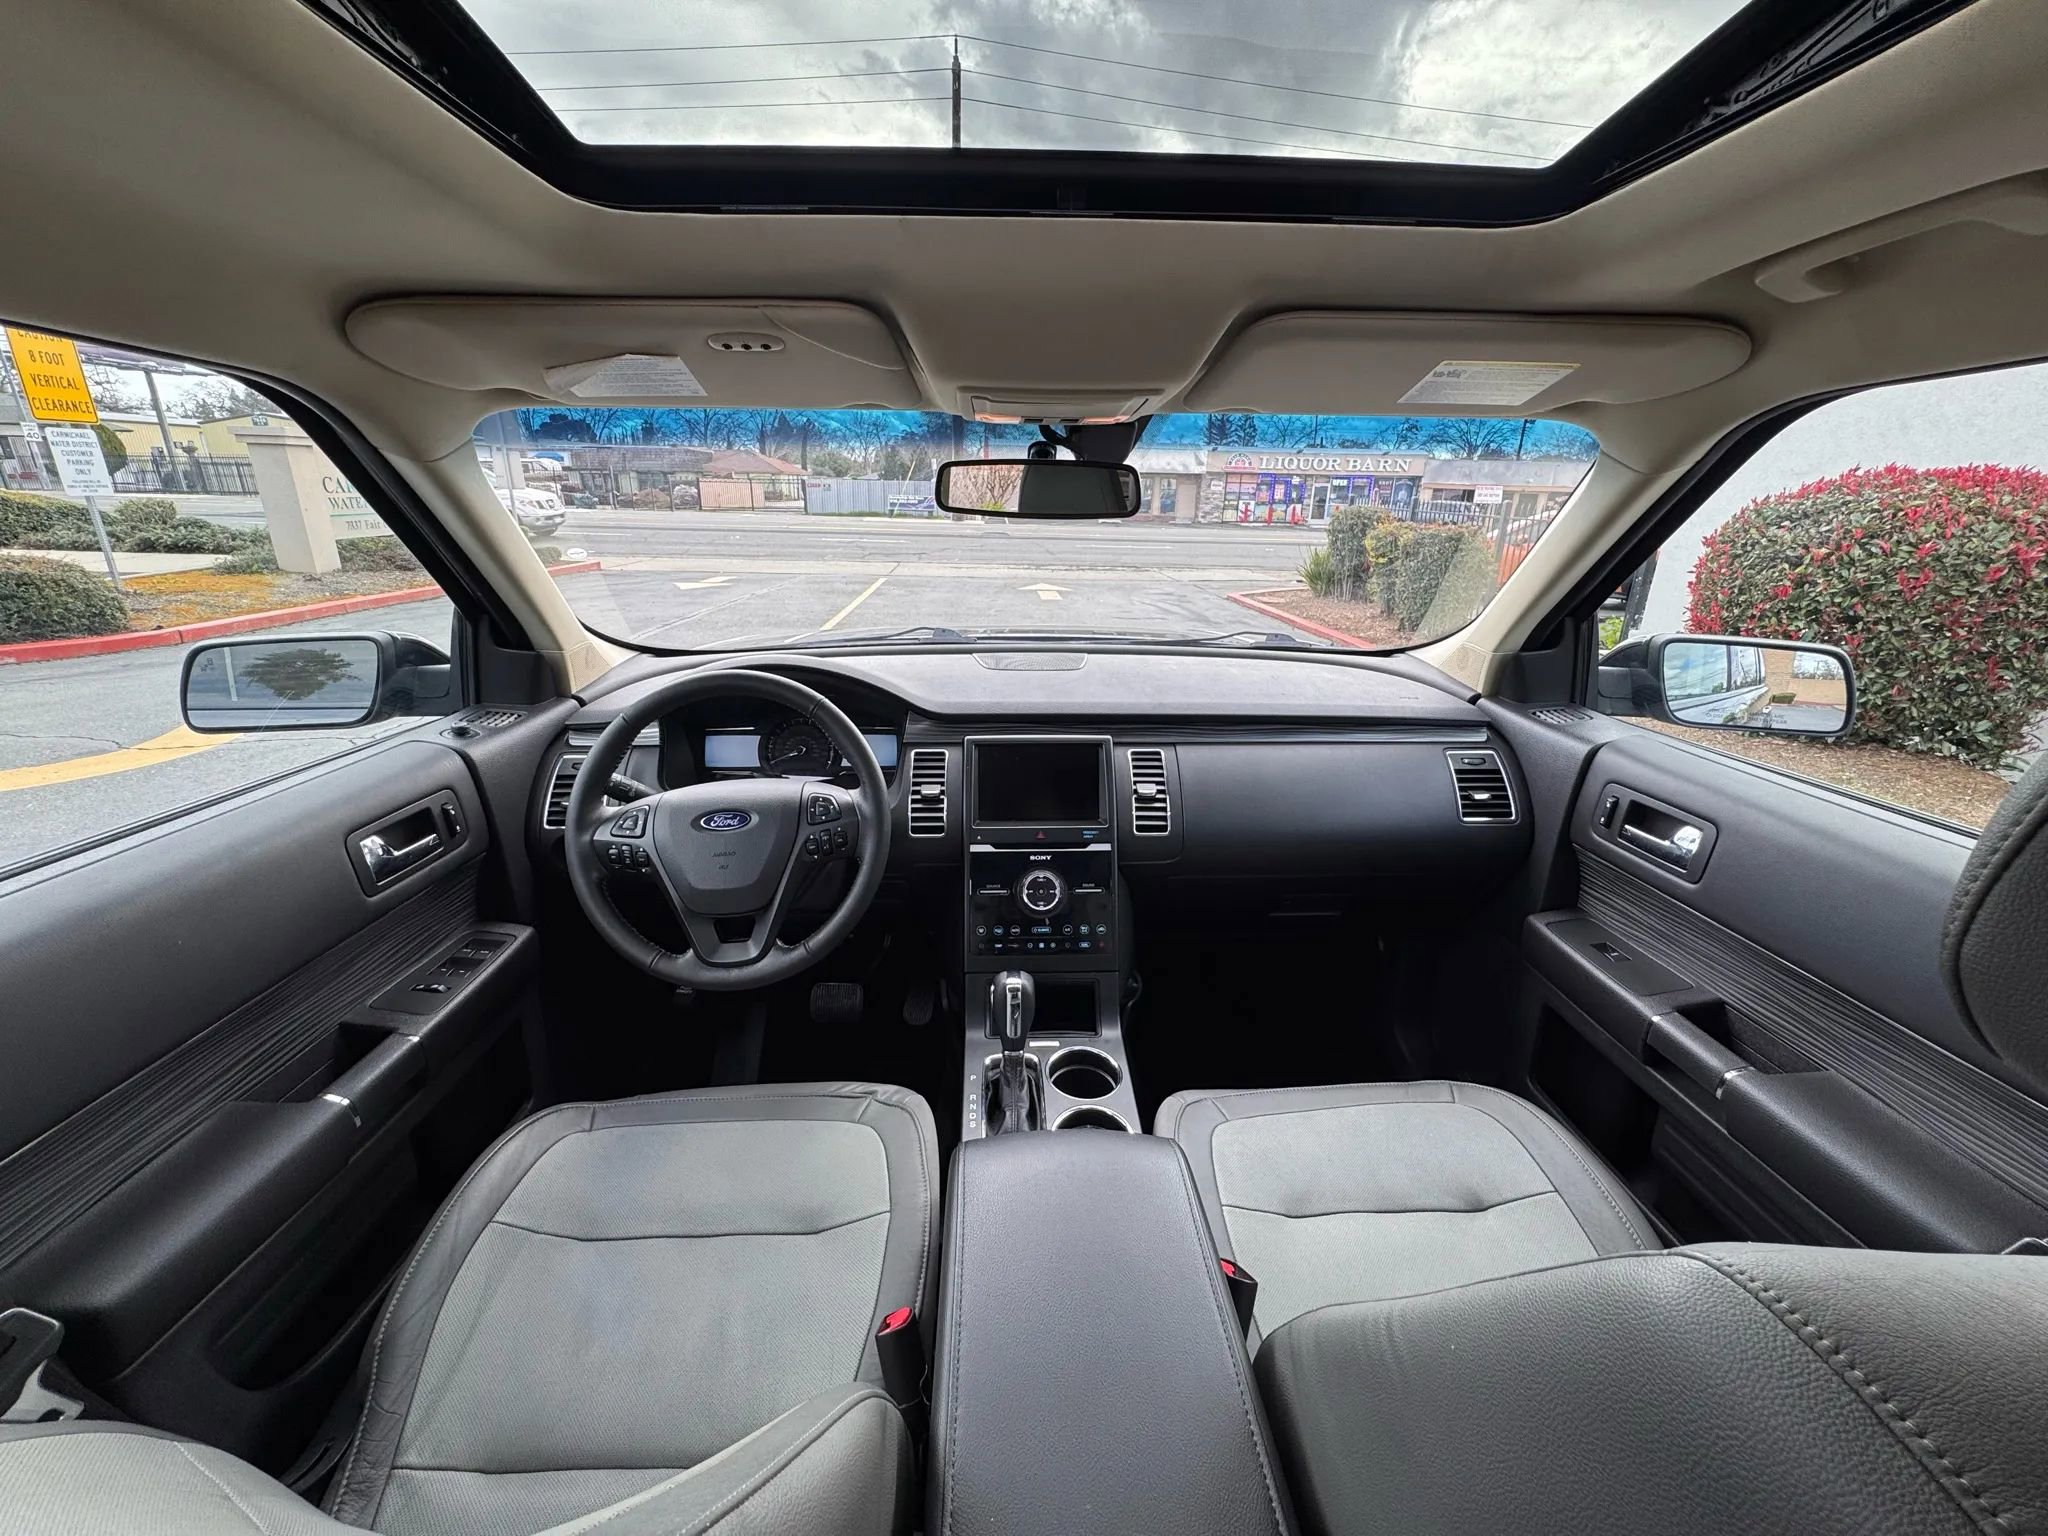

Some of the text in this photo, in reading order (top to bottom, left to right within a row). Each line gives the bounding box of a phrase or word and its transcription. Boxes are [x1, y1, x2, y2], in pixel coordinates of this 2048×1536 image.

[28, 349, 65, 366] 8 FOOT
[29, 372, 80, 390] VERTICAL
[31, 396, 93, 414] CLEARANCE
[26, 431, 40, 440] 40
[51, 430, 92, 440] CARMICHAEL
[50, 440, 99, 449] WATER DISTRICT
[60, 449, 94, 457] CUSTOMER
[66, 458, 95, 467] PARKING
[1259, 456, 1341, 472] LIQUOR
[1345, 457, 1412, 473] BARN
[74, 468, 92, 476] ONLY
[322, 476, 353, 494] CA
[328, 496, 369, 510] WATE
[364, 519, 381, 530] Fair
[710, 814, 740, 827] Ford
[969, 1120, 977, 1128] S
